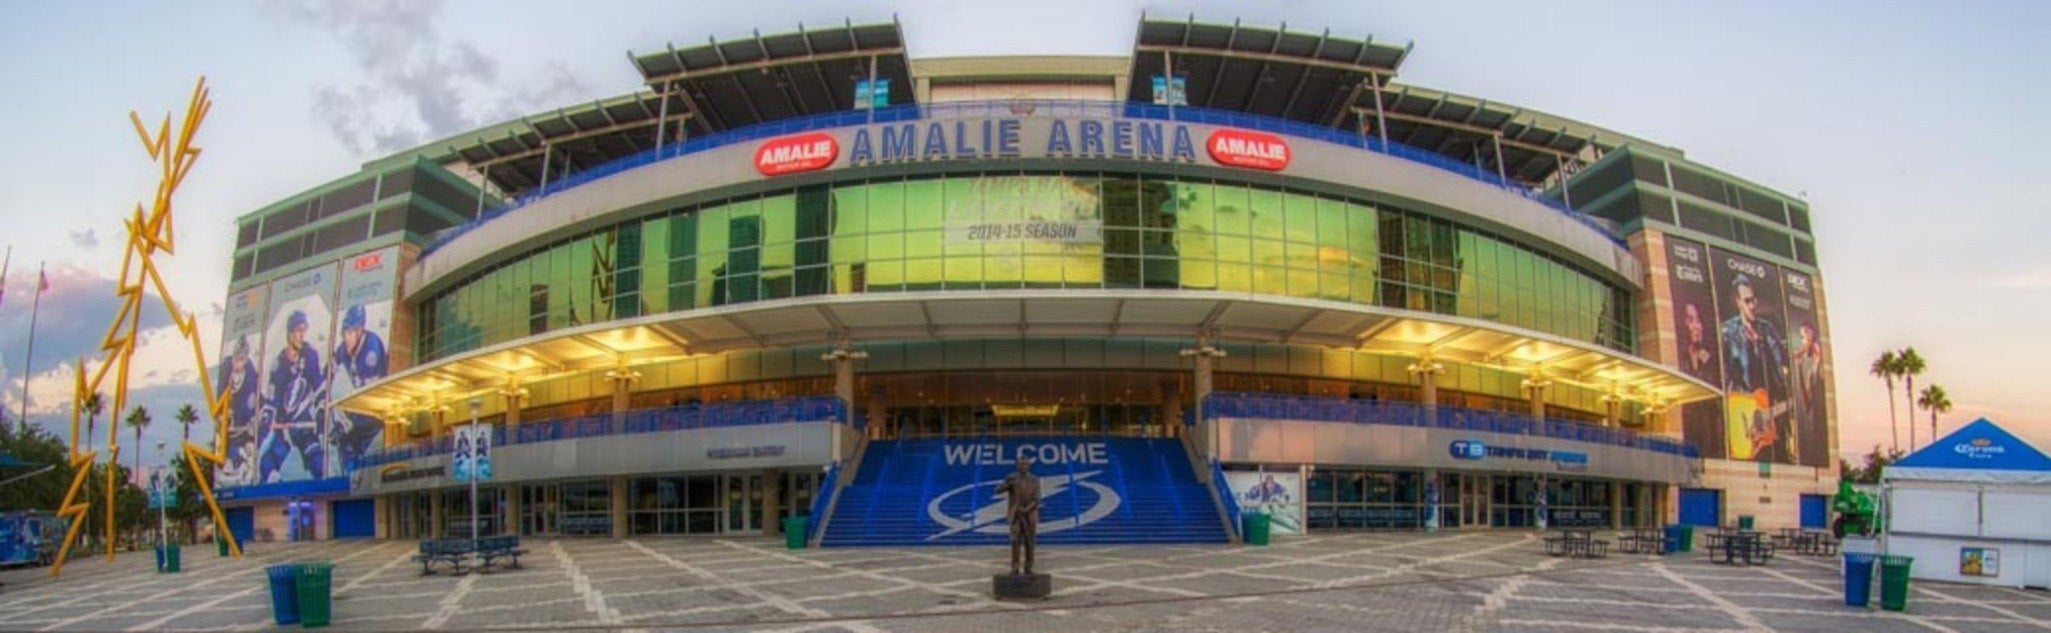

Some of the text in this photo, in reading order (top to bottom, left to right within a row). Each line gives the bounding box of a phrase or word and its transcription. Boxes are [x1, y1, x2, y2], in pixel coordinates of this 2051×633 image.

[850, 119, 1195, 164] AMALIE ARENA
[1216, 138, 1286, 160] AMALIE
[760, 142, 830, 165] AMALIE
[1023, 222, 1078, 239] SEASON
[945, 443, 1108, 466] WELCOME
[1954, 444, 2003, 453] Corona
